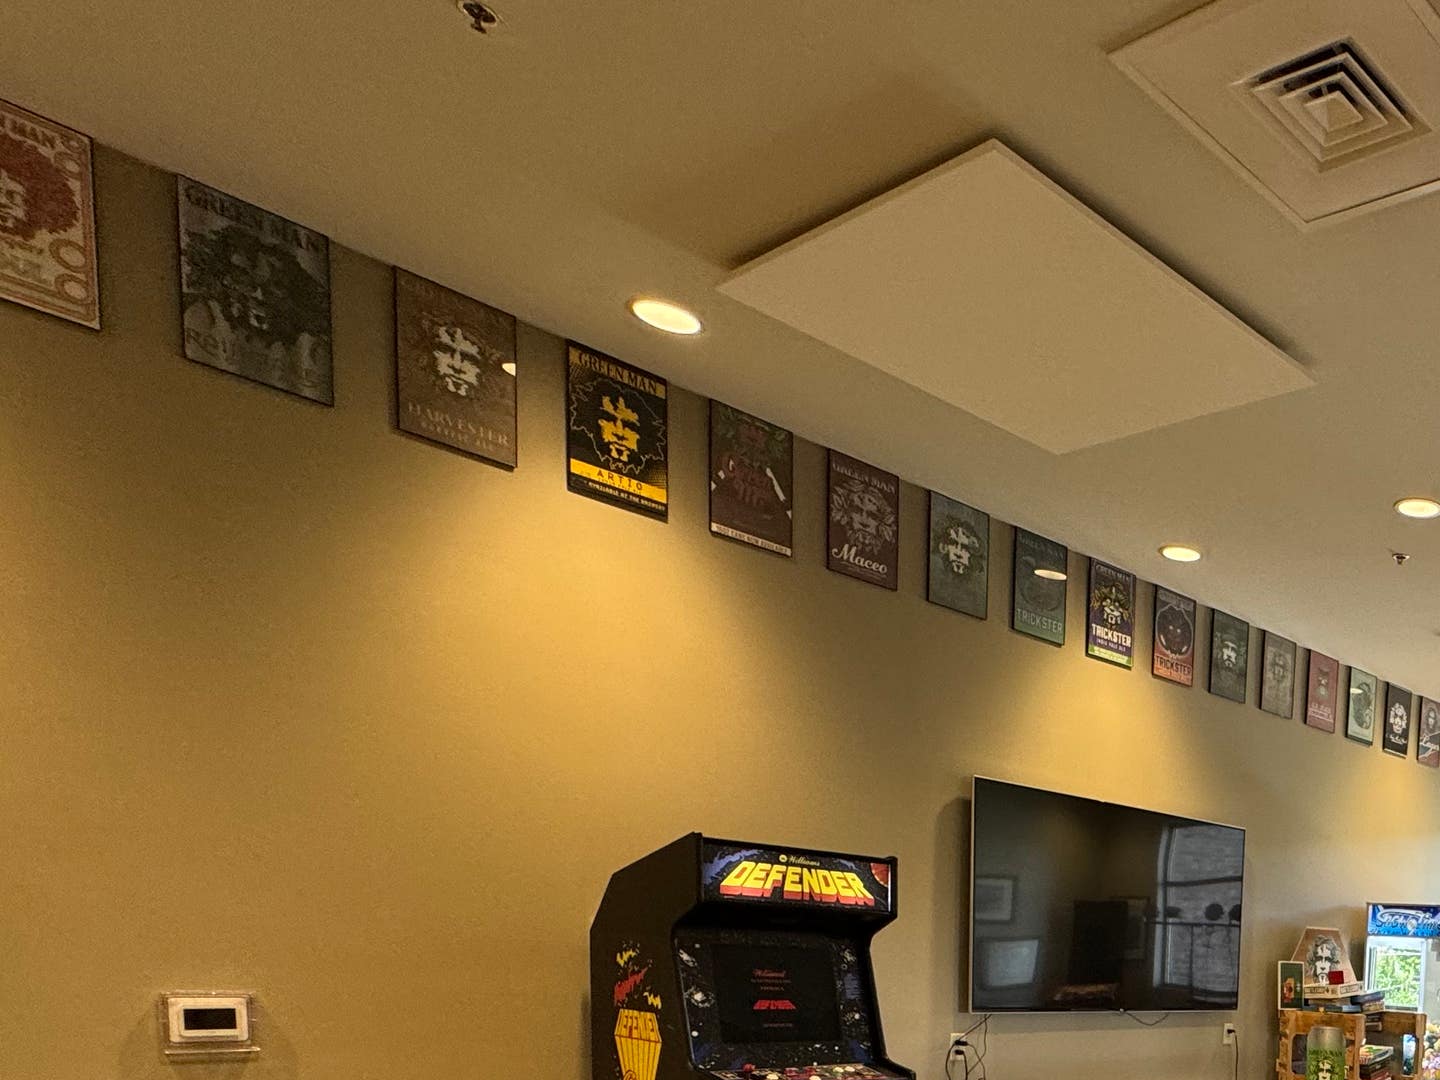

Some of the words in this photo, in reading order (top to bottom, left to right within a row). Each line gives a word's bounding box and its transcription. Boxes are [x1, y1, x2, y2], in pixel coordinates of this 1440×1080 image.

[578, 351, 624, 384] GREEN
[628, 372, 658, 394] MAN
[596, 468, 643, 491] ARTIO
[831, 543, 888, 574] Maceo
[1016, 608, 1064, 634] TRICKSTER
[1091, 623, 1132, 648] TRICKSTER
[1154, 655, 1193, 674] TRICKSTER
[788, 855, 821, 867] Williams
[720, 861, 875, 906] DEFENDER
